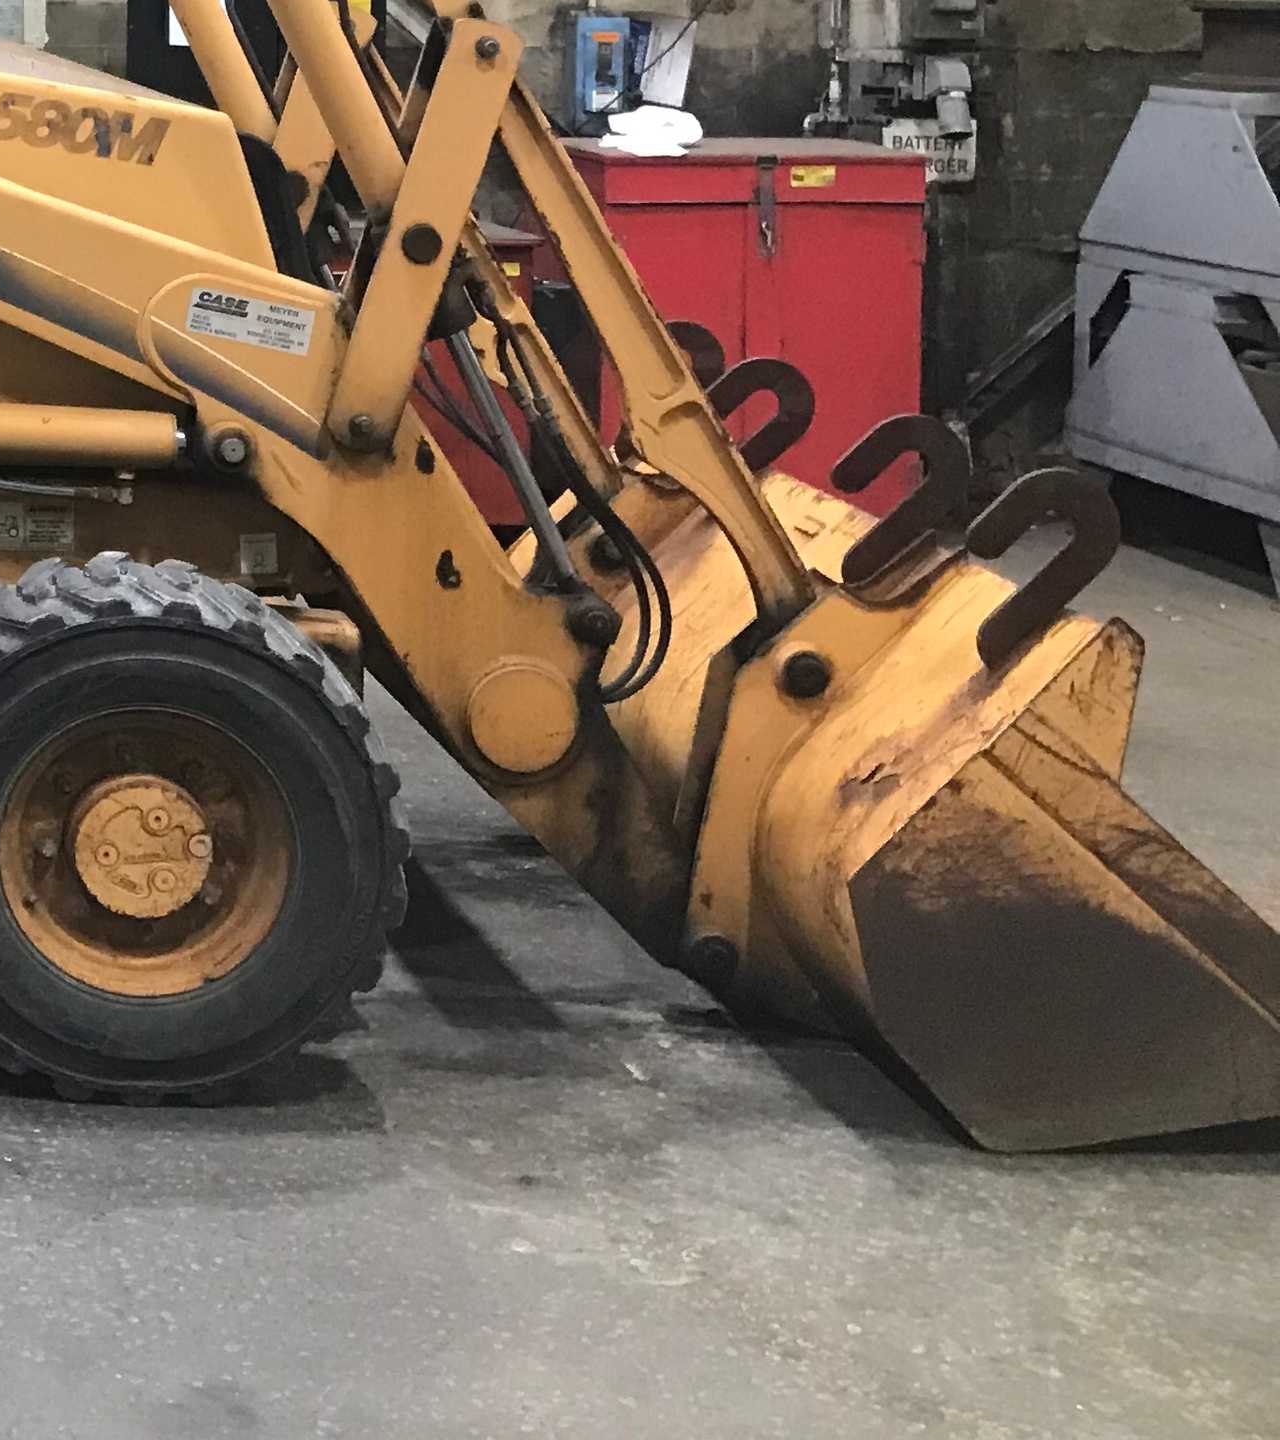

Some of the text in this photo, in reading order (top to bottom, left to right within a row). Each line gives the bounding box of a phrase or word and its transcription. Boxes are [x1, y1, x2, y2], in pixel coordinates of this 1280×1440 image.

[893, 135, 965, 151] BATTERY
[198, 291, 250, 311] CASE
[256, 314, 307, 331] EQUIPMENT
